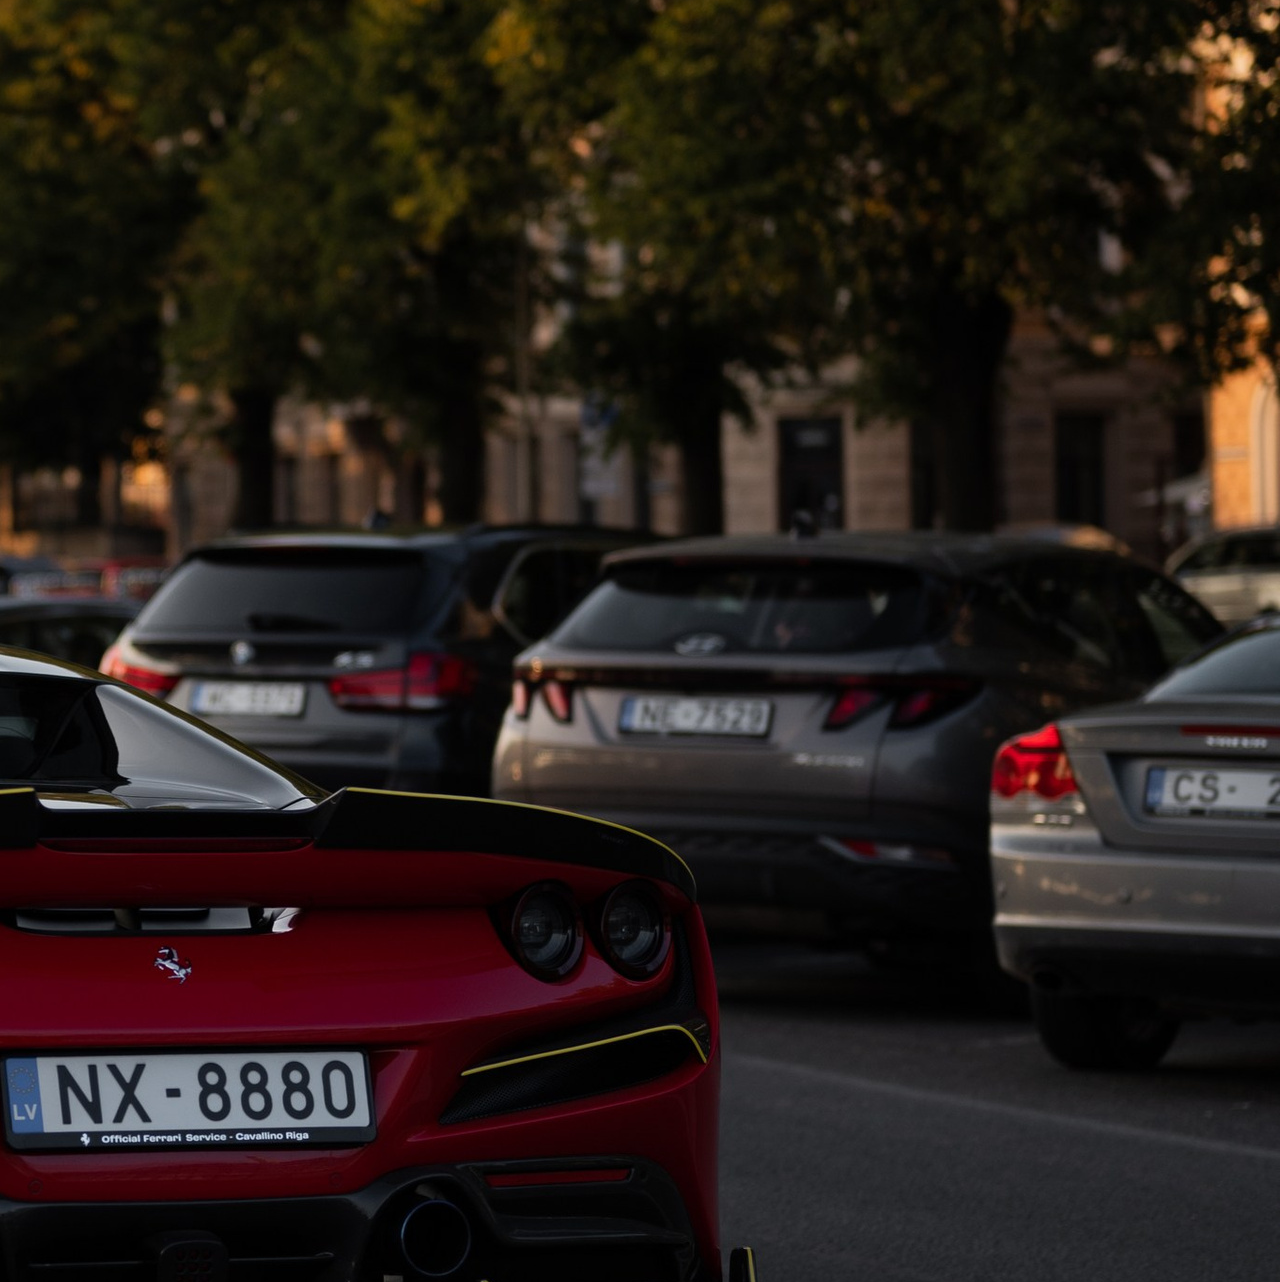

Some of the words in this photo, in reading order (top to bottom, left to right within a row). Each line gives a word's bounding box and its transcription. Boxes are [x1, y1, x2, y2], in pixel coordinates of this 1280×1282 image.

[55, 1060, 357, 1125] NX-8880
[12, 1103, 38, 1121] LV
[101, 1133, 141, 1144] Official
[143, 1133, 182, 1143] Ferrari
[185, 1132, 227, 1142] Service
[236, 1131, 284, 1141] Cavallino
[286, 1131, 310, 1141] Riga
